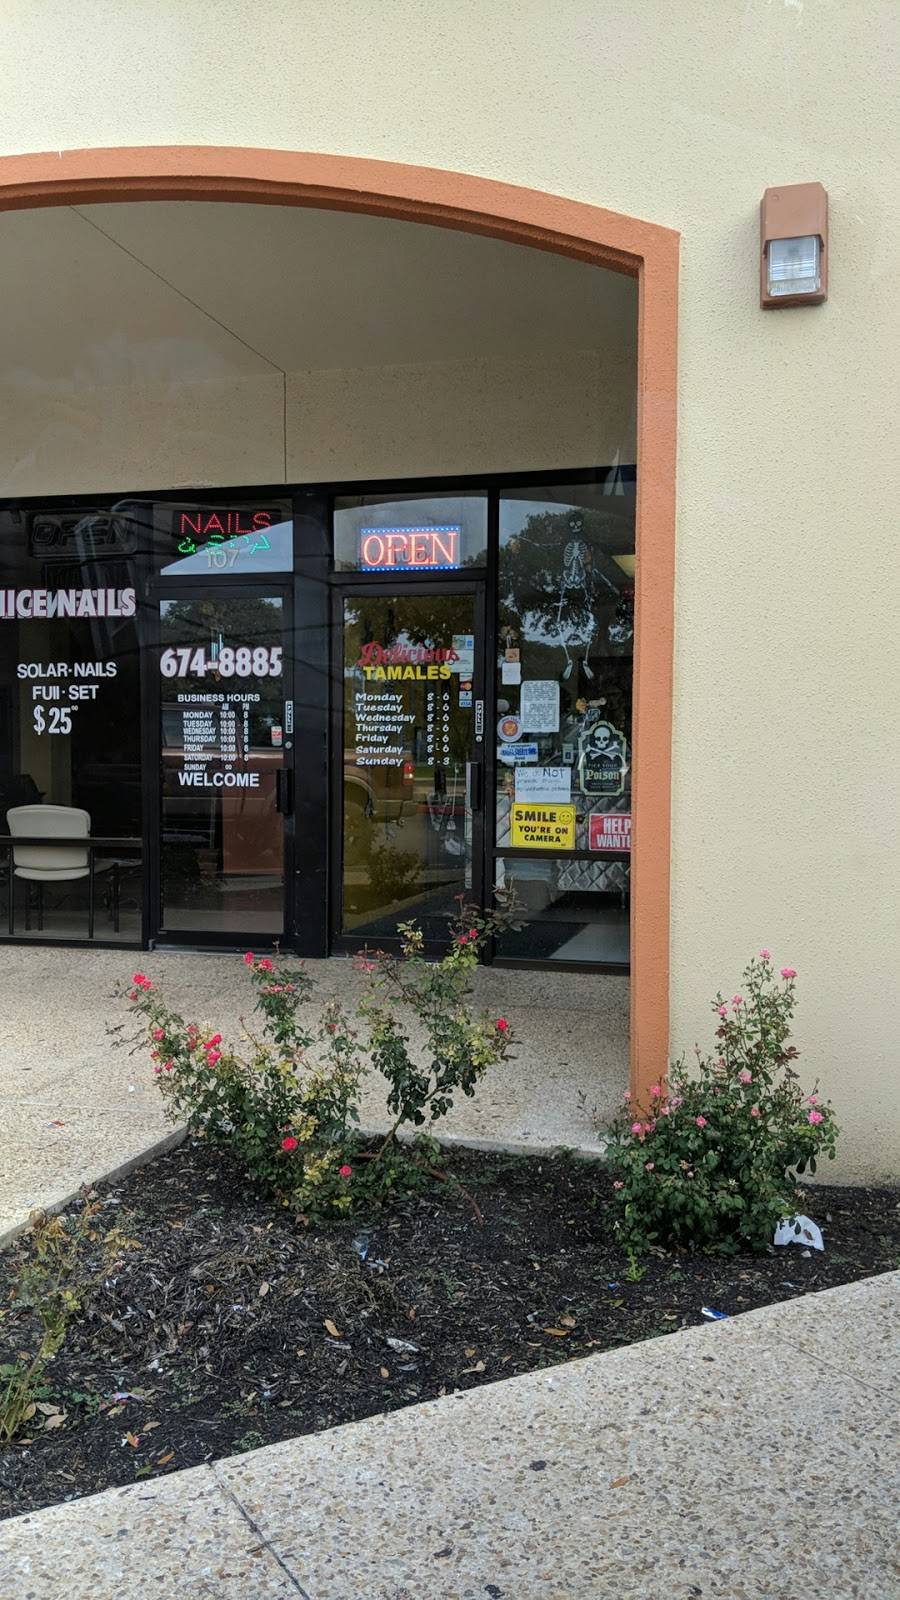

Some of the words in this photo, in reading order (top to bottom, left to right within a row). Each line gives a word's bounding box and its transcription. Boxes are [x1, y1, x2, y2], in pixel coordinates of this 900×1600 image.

[179, 511, 272, 534] NAILS
[363, 532, 457, 566] OPEN
[206, 549, 239, 568] 107
[57, 588, 137, 617] NAILS
[160, 647, 283, 678] 674-8885
[363, 665, 452, 680] TAMALES
[68, 685, 100, 700] SET
[177, 694, 225, 702] BUSINESS
[226, 693, 261, 702] HOURS
[356, 693, 403, 703] Monday
[356, 703, 403, 713] Tuesday
[183, 720, 213, 728] TUESDAY
[356, 714, 416, 723] Wednesday
[356, 724, 403, 733] Thursday
[356, 734, 388, 744] Friday
[356, 745, 403, 755] Saturday
[356, 757, 404, 767] Sunday
[178, 772, 260, 787] WELCOME
[585, 768, 620, 780] Poison
[515, 810, 557, 823] SMILE
[518, 825, 552, 834] YOU'RE
[554, 826, 569, 835] ON
[603, 817, 631, 835] HELP
[524, 834, 561, 843] CAMERA
